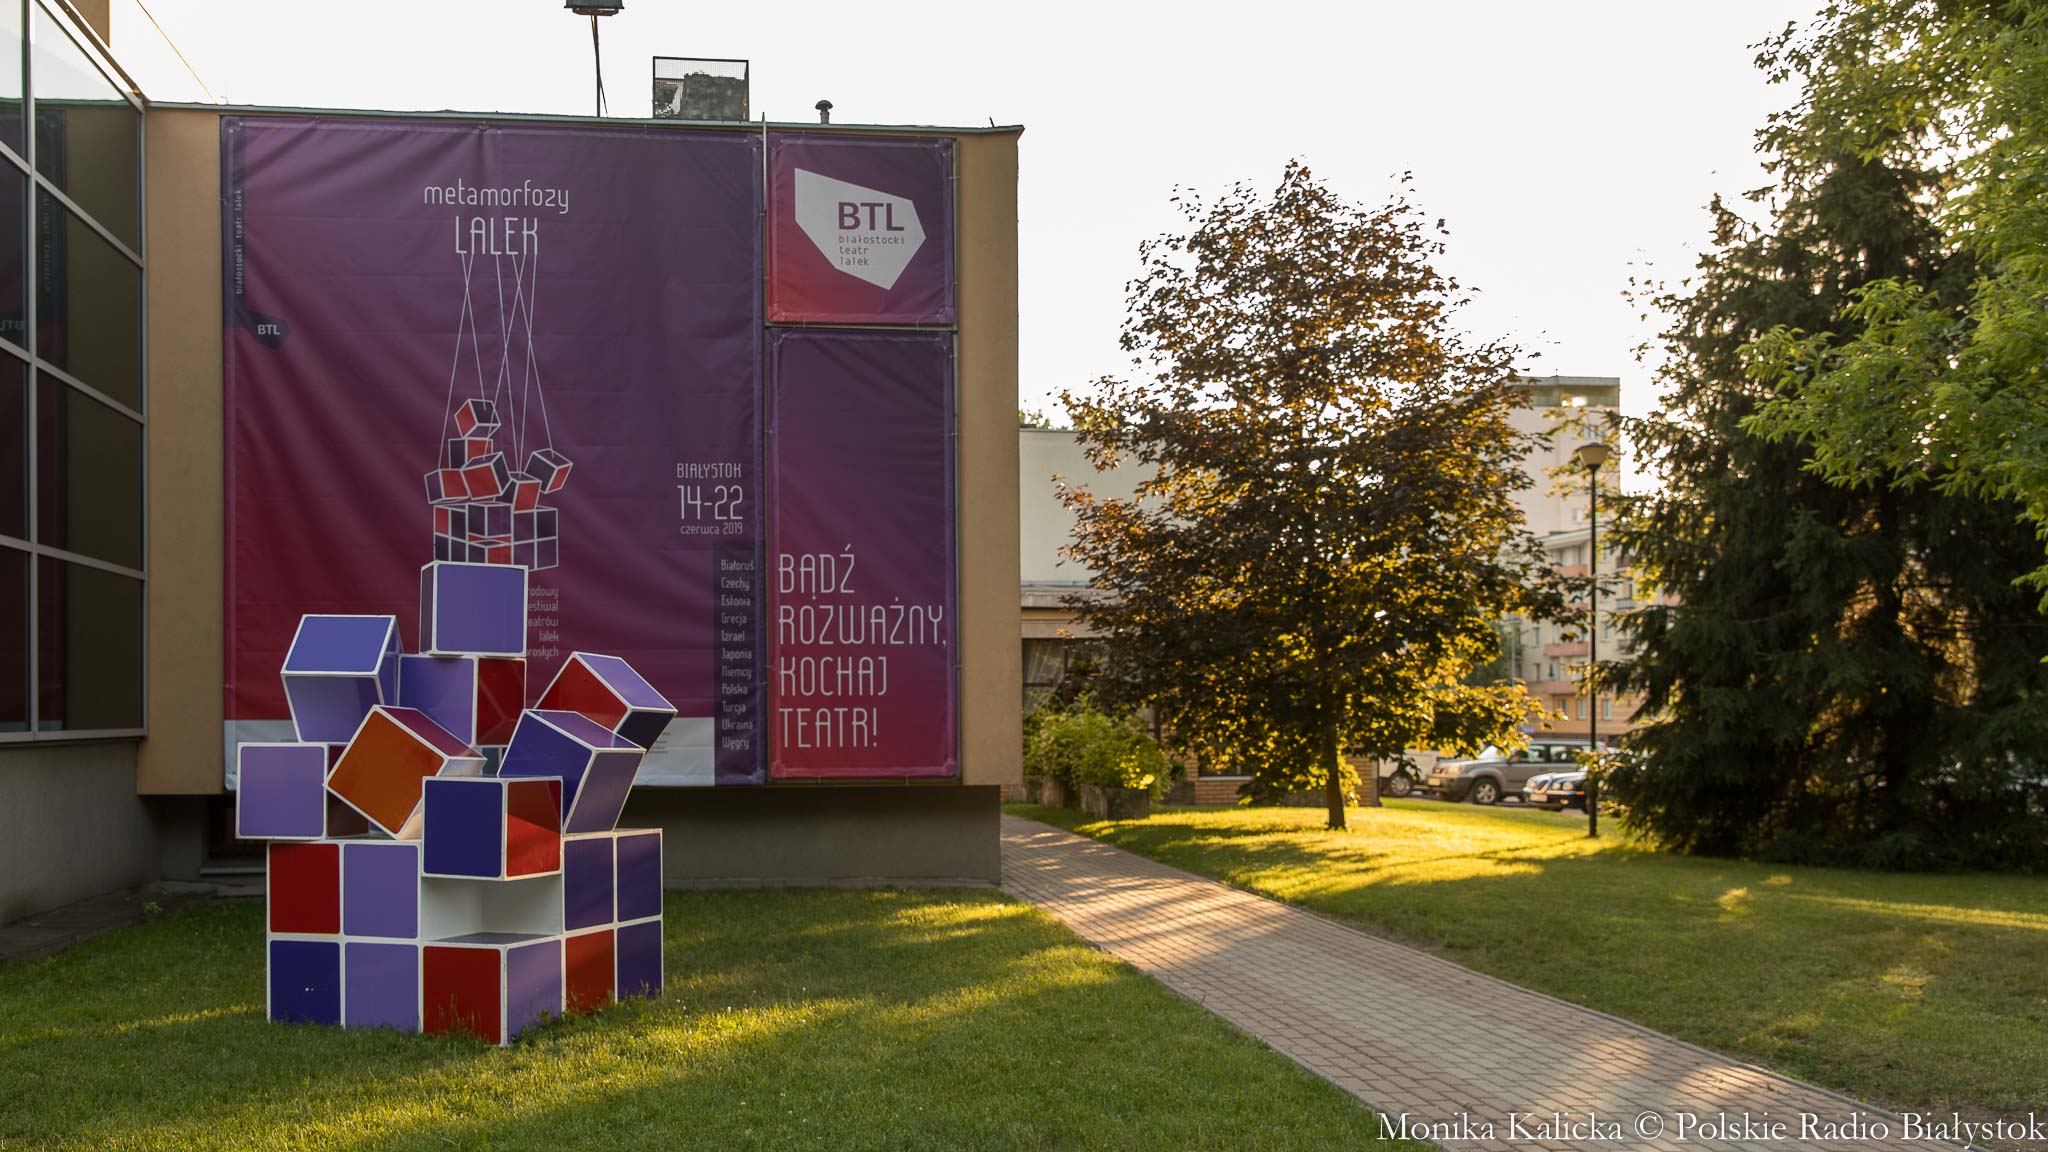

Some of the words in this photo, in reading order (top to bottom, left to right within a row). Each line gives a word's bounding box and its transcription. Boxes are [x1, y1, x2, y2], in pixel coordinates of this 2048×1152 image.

[234, 189, 243, 211] lalek
[424, 178, 569, 214] metamorfozy
[838, 202, 904, 231] BTL
[235, 217, 243, 239] teatr
[456, 216, 538, 255] LALEK
[838, 235, 905, 245] białostocki
[840, 246, 869, 255] teatr
[839, 257, 870, 266] lalek
[257, 324, 280, 335] BTL
[676, 463, 742, 478] BIAŁYSTOK
[677, 485, 743, 520] 14-22
[680, 525, 719, 535] czerwca
[722, 522, 743, 535] 2019
[720, 559, 755, 571] Białoruś
[779, 544, 855, 600] BĄDŹ
[721, 577, 750, 591] Czechy
[528, 600, 559, 611] estiwal
[721, 595, 751, 606] Estonia
[528, 616, 559, 627] eatrów
[721, 612, 747, 625] Grecja
[779, 597, 947, 646] ROZWAŻNY,
[538, 630, 559, 641] lalek
[721, 630, 745, 642] Izrael
[721, 648, 752, 662] Japonia
[721, 665, 752, 680] Niemcy
[779, 656, 887, 696] KOCHAJ
[721, 683, 748, 695] Polska
[722, 701, 746, 714] Turcja
[721, 719, 753, 731] Ukraina
[779, 707, 878, 748] TEATR!
[722, 736, 750, 750] Węgry
